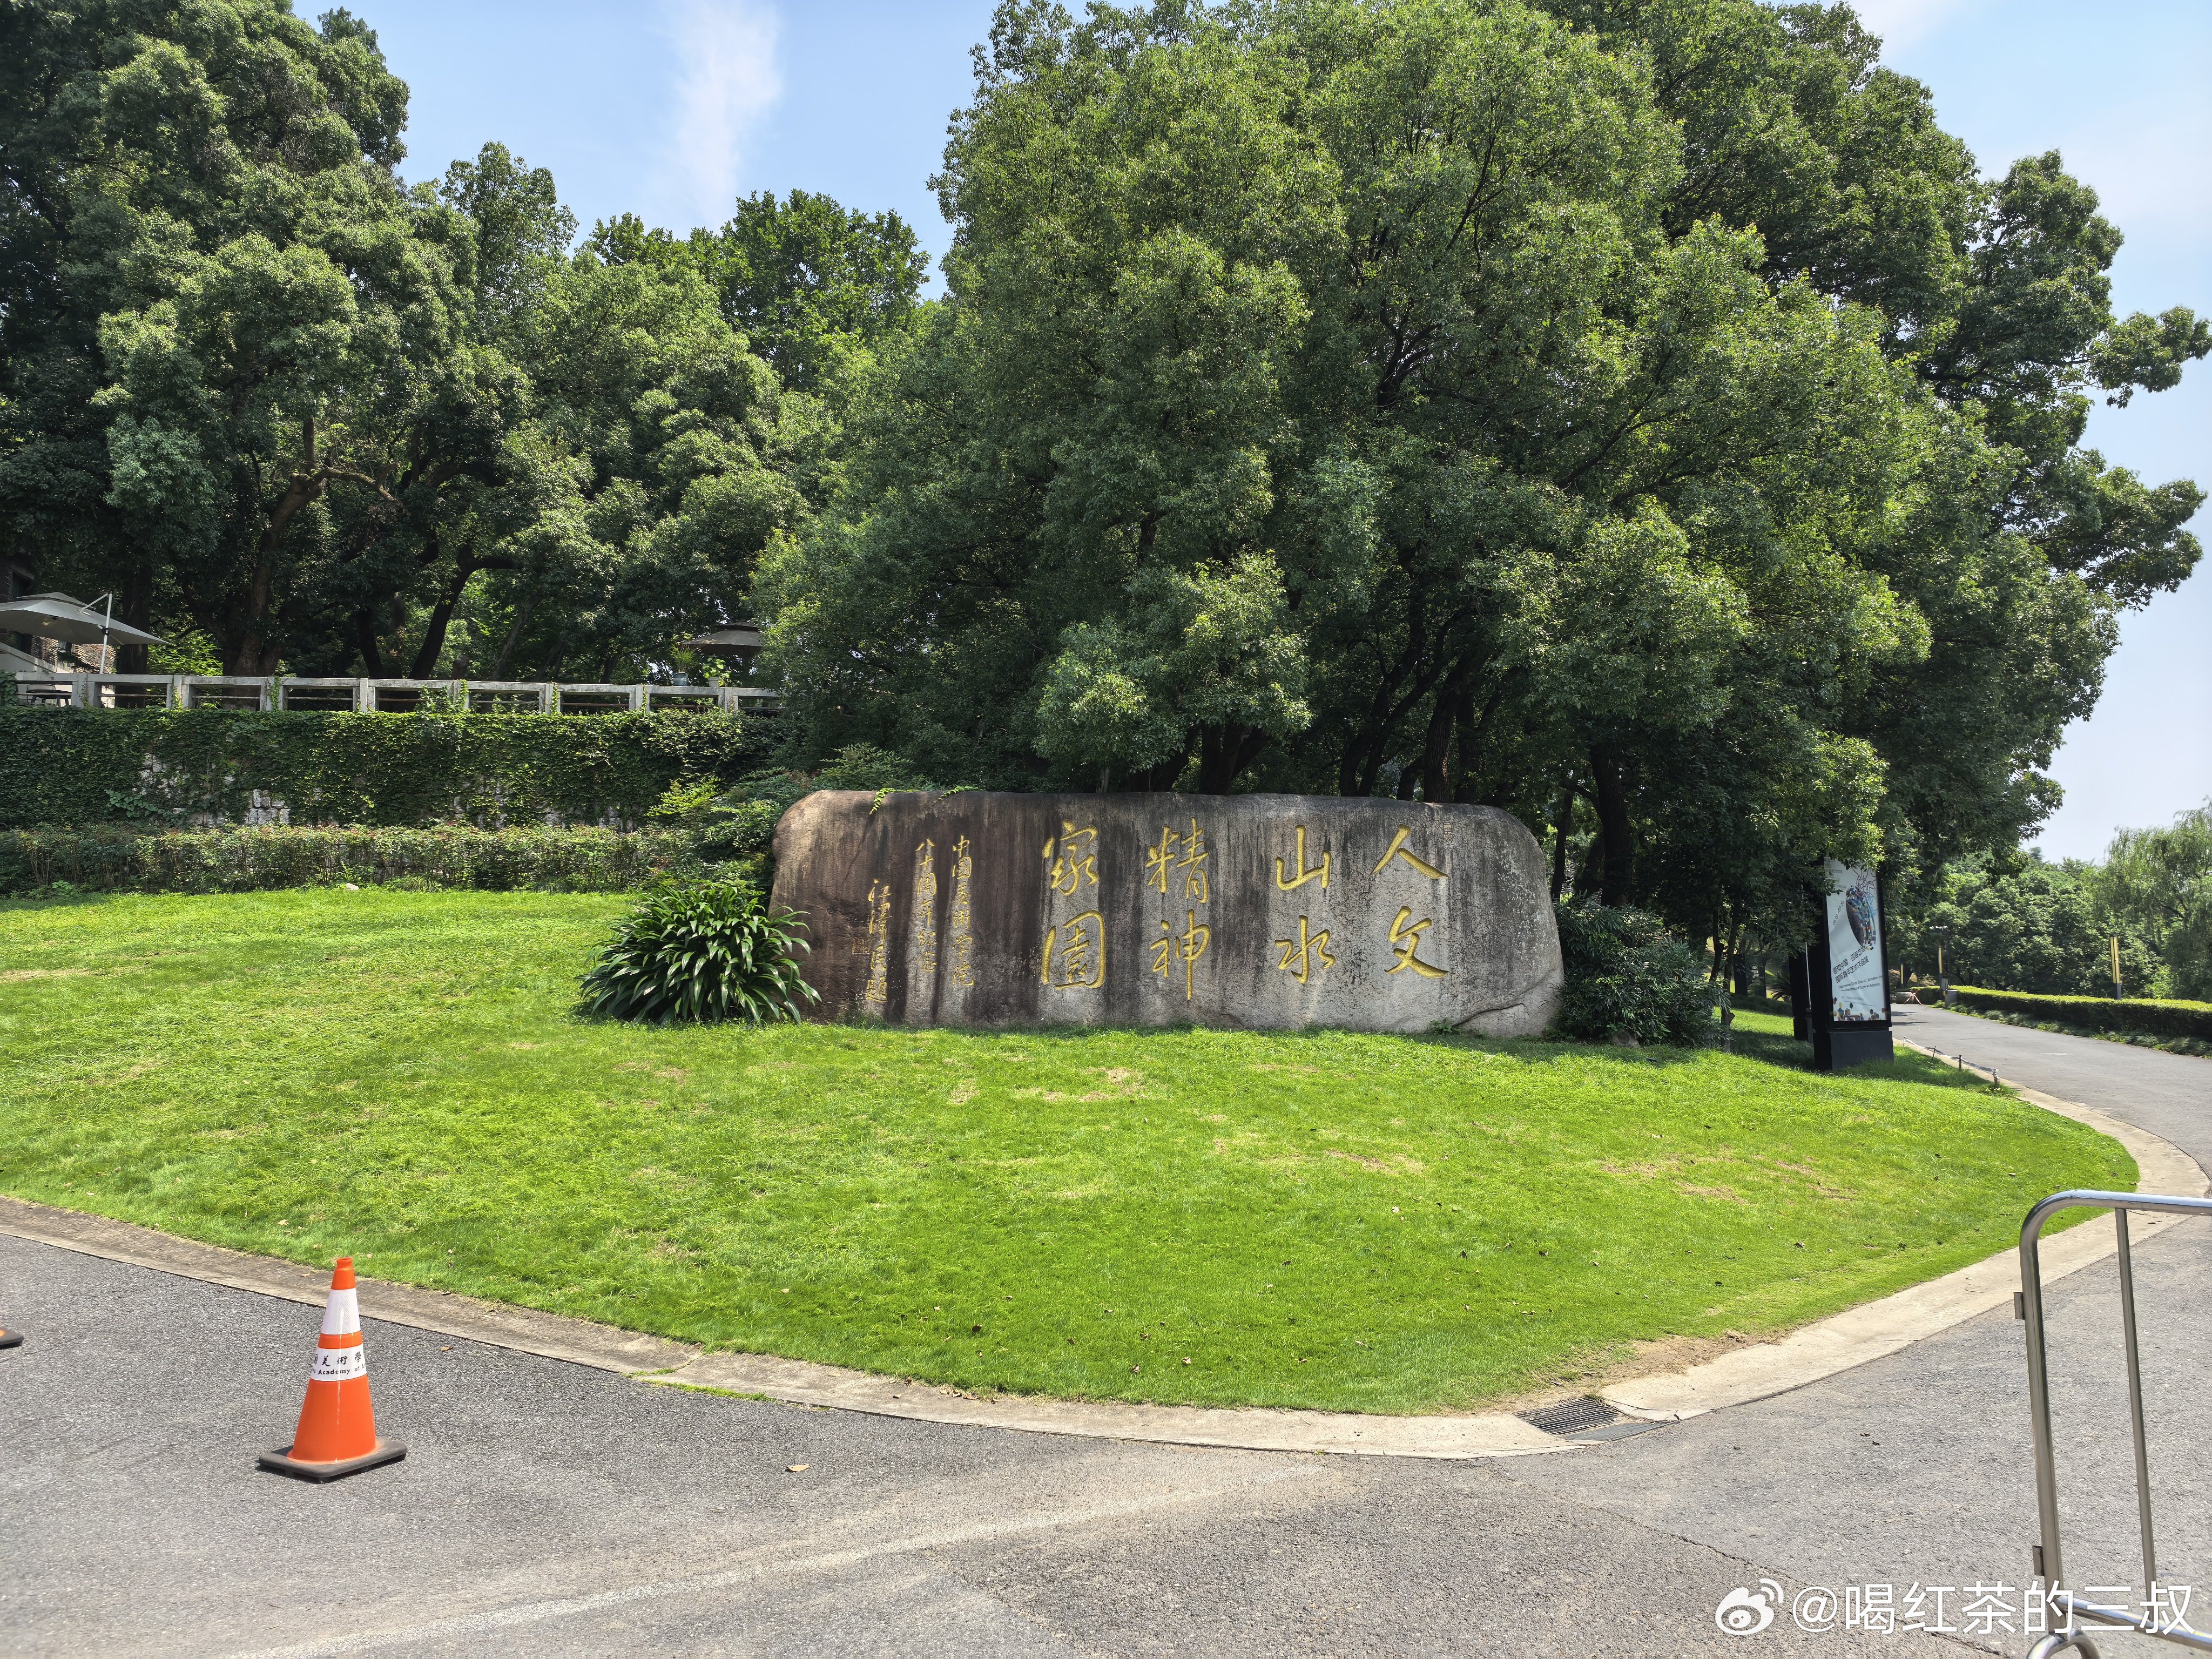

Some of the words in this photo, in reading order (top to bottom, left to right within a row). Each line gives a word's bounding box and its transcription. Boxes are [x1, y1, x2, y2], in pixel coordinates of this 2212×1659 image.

[1145, 817, 1211, 1000] 精神
[1275, 825, 1336, 984] 山水
[1372, 824, 1448, 979] 人文
